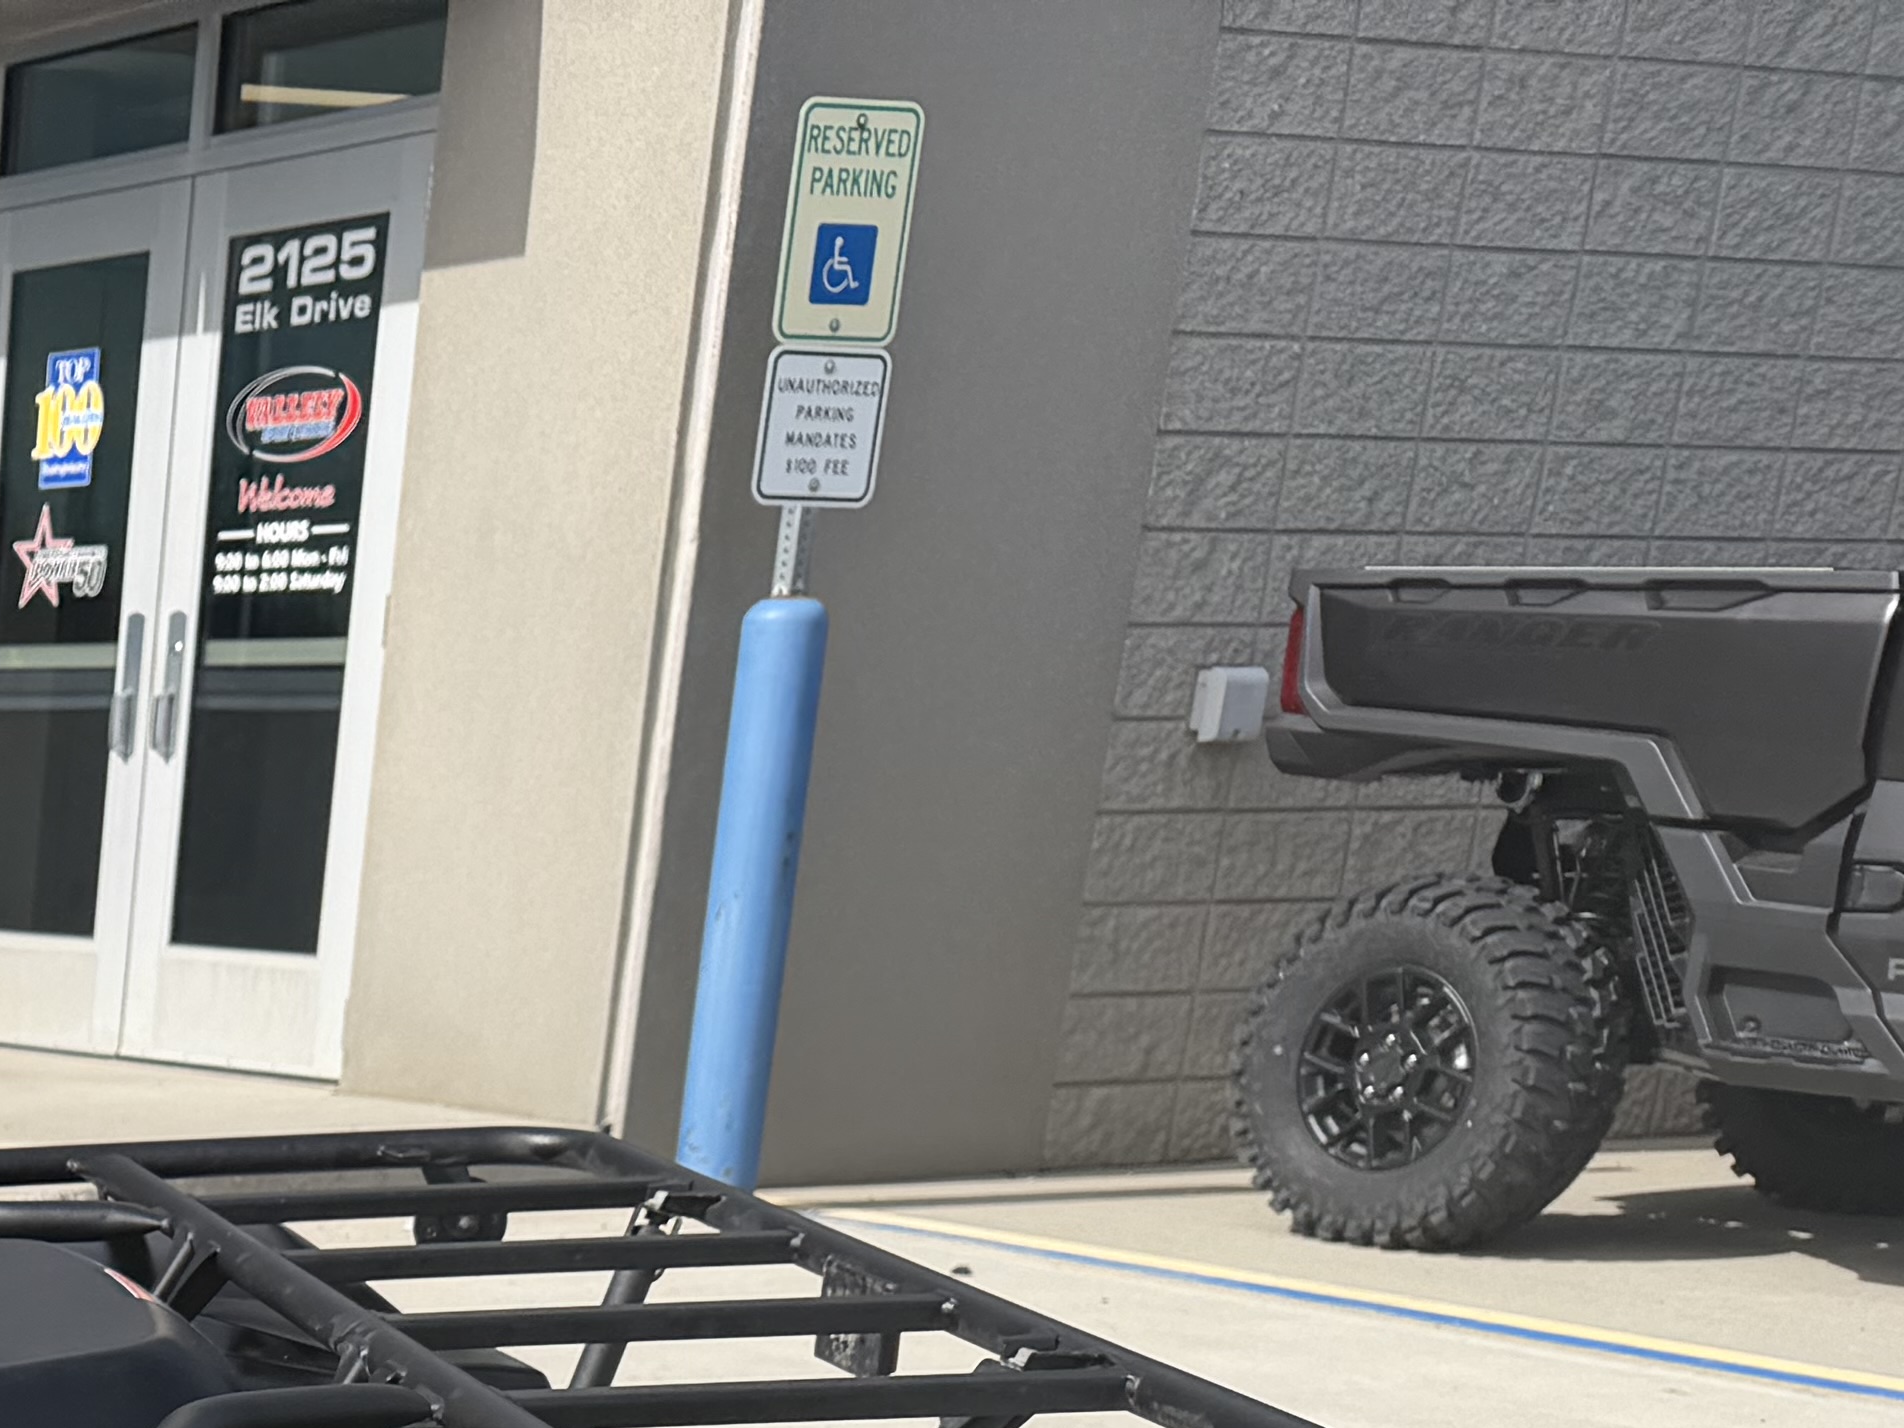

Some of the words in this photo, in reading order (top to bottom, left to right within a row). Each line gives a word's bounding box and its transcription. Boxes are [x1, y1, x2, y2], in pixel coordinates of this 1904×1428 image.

[807, 124, 912, 158] RESERVED
[809, 166, 899, 199] PARKING
[238, 226, 377, 296] 2125
[234, 299, 280, 334] Elk
[290, 290, 372, 327] Drive
[55, 356, 92, 383] TOP
[777, 377, 881, 397] UNAUTHORIZED
[31, 380, 104, 461] 100
[795, 405, 855, 422] PARKING
[784, 431, 857, 449] MANDATES
[823, 459, 850, 476] FEE
[238, 472, 336, 514] Welcome
[256, 519, 311, 544] HOURS
